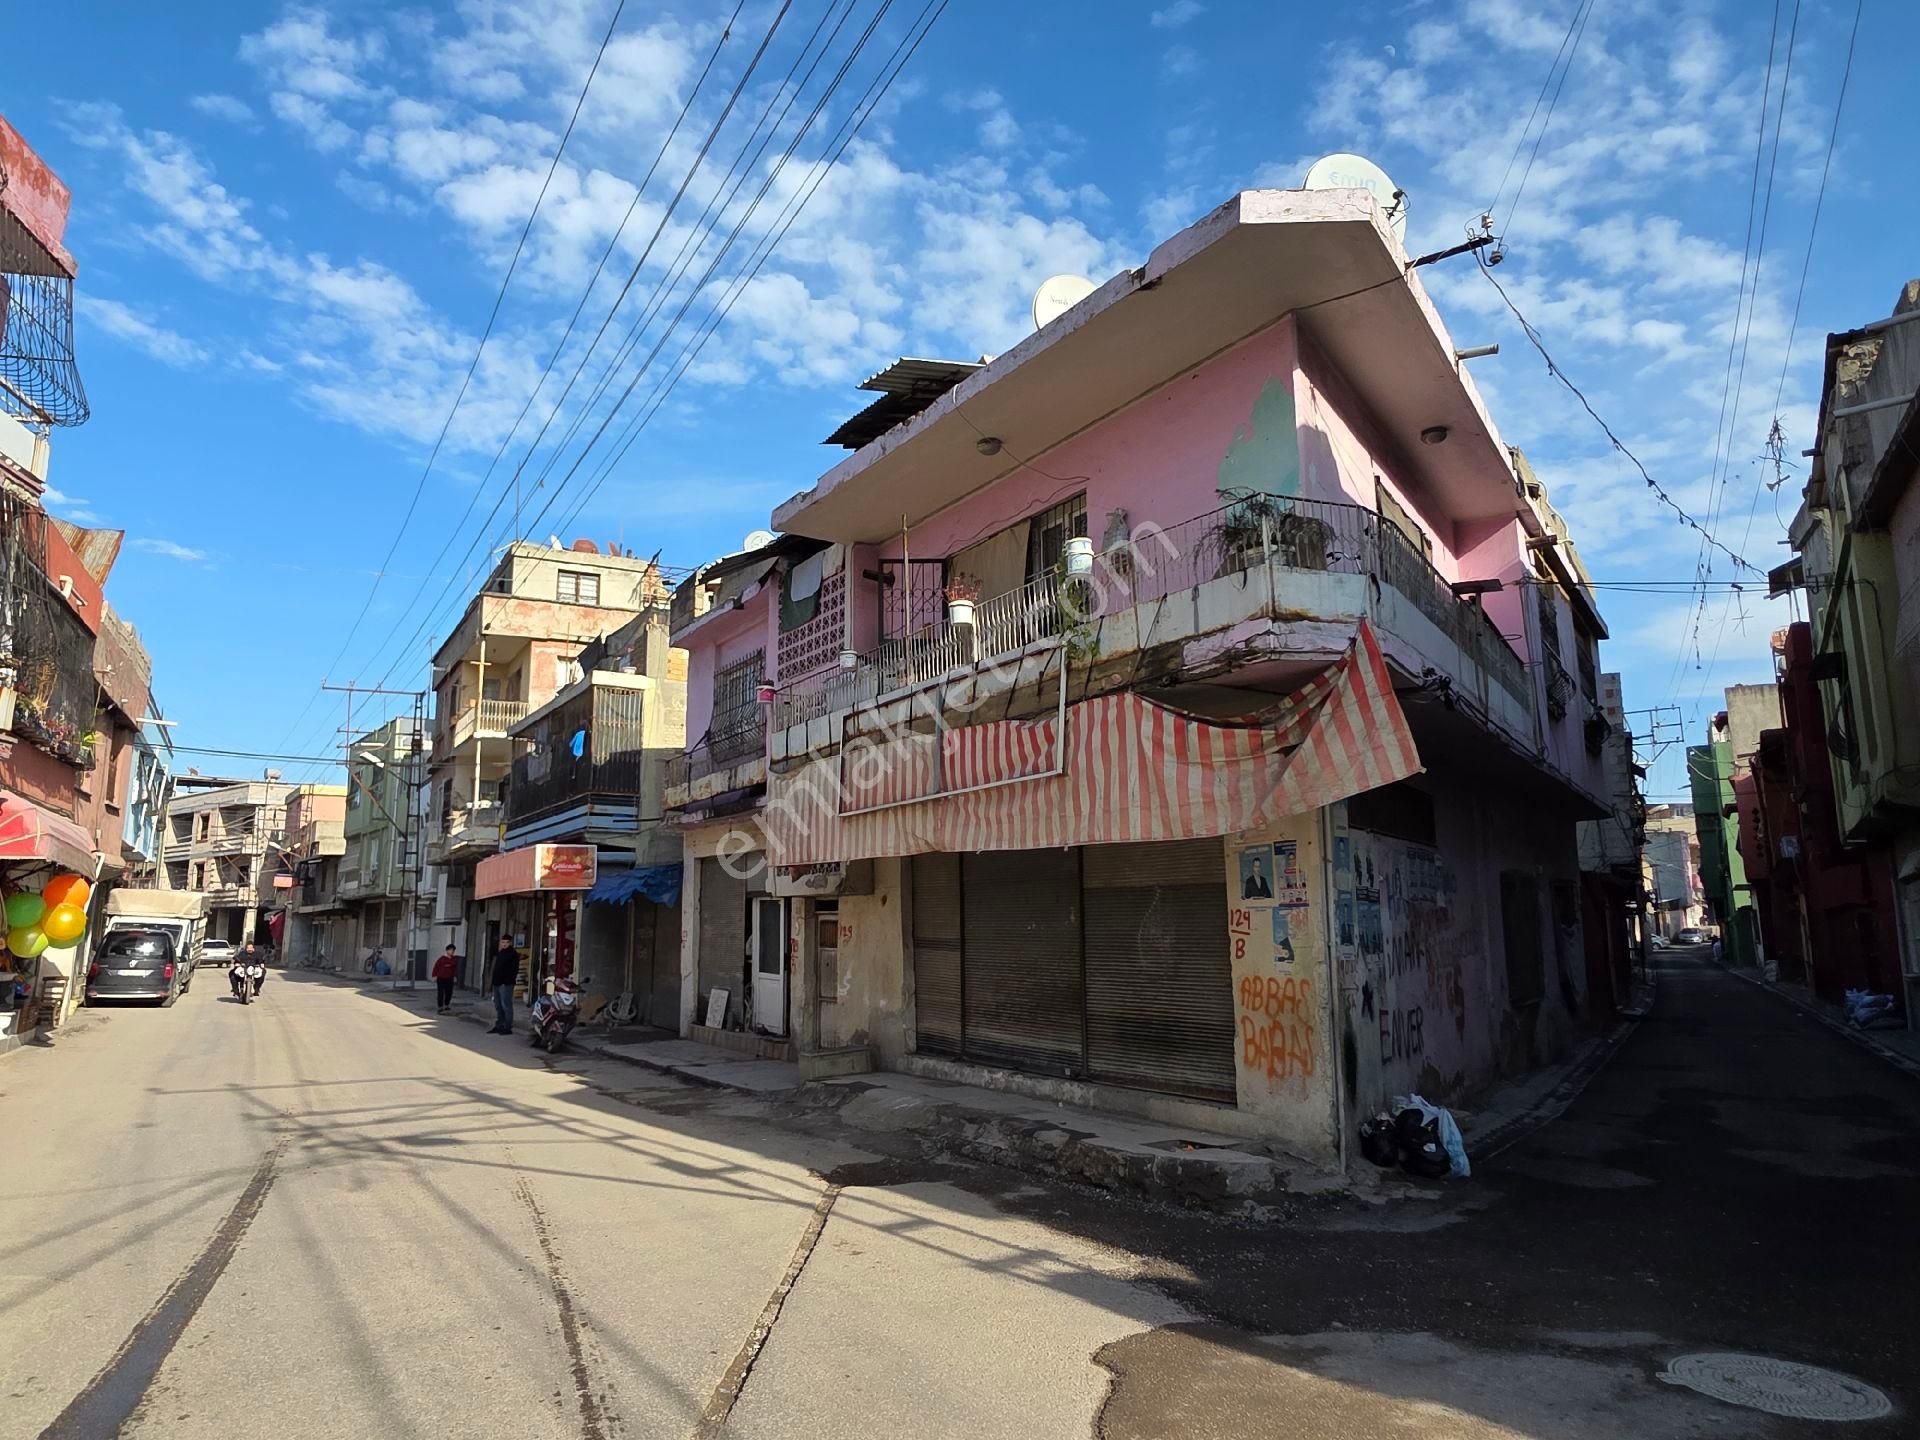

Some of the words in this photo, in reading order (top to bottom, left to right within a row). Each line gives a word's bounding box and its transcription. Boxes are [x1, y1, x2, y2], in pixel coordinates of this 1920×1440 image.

[1229, 908, 1251, 931] 129
[1235, 939, 1246, 960] B
[1379, 1006, 1425, 1066] ENVER
